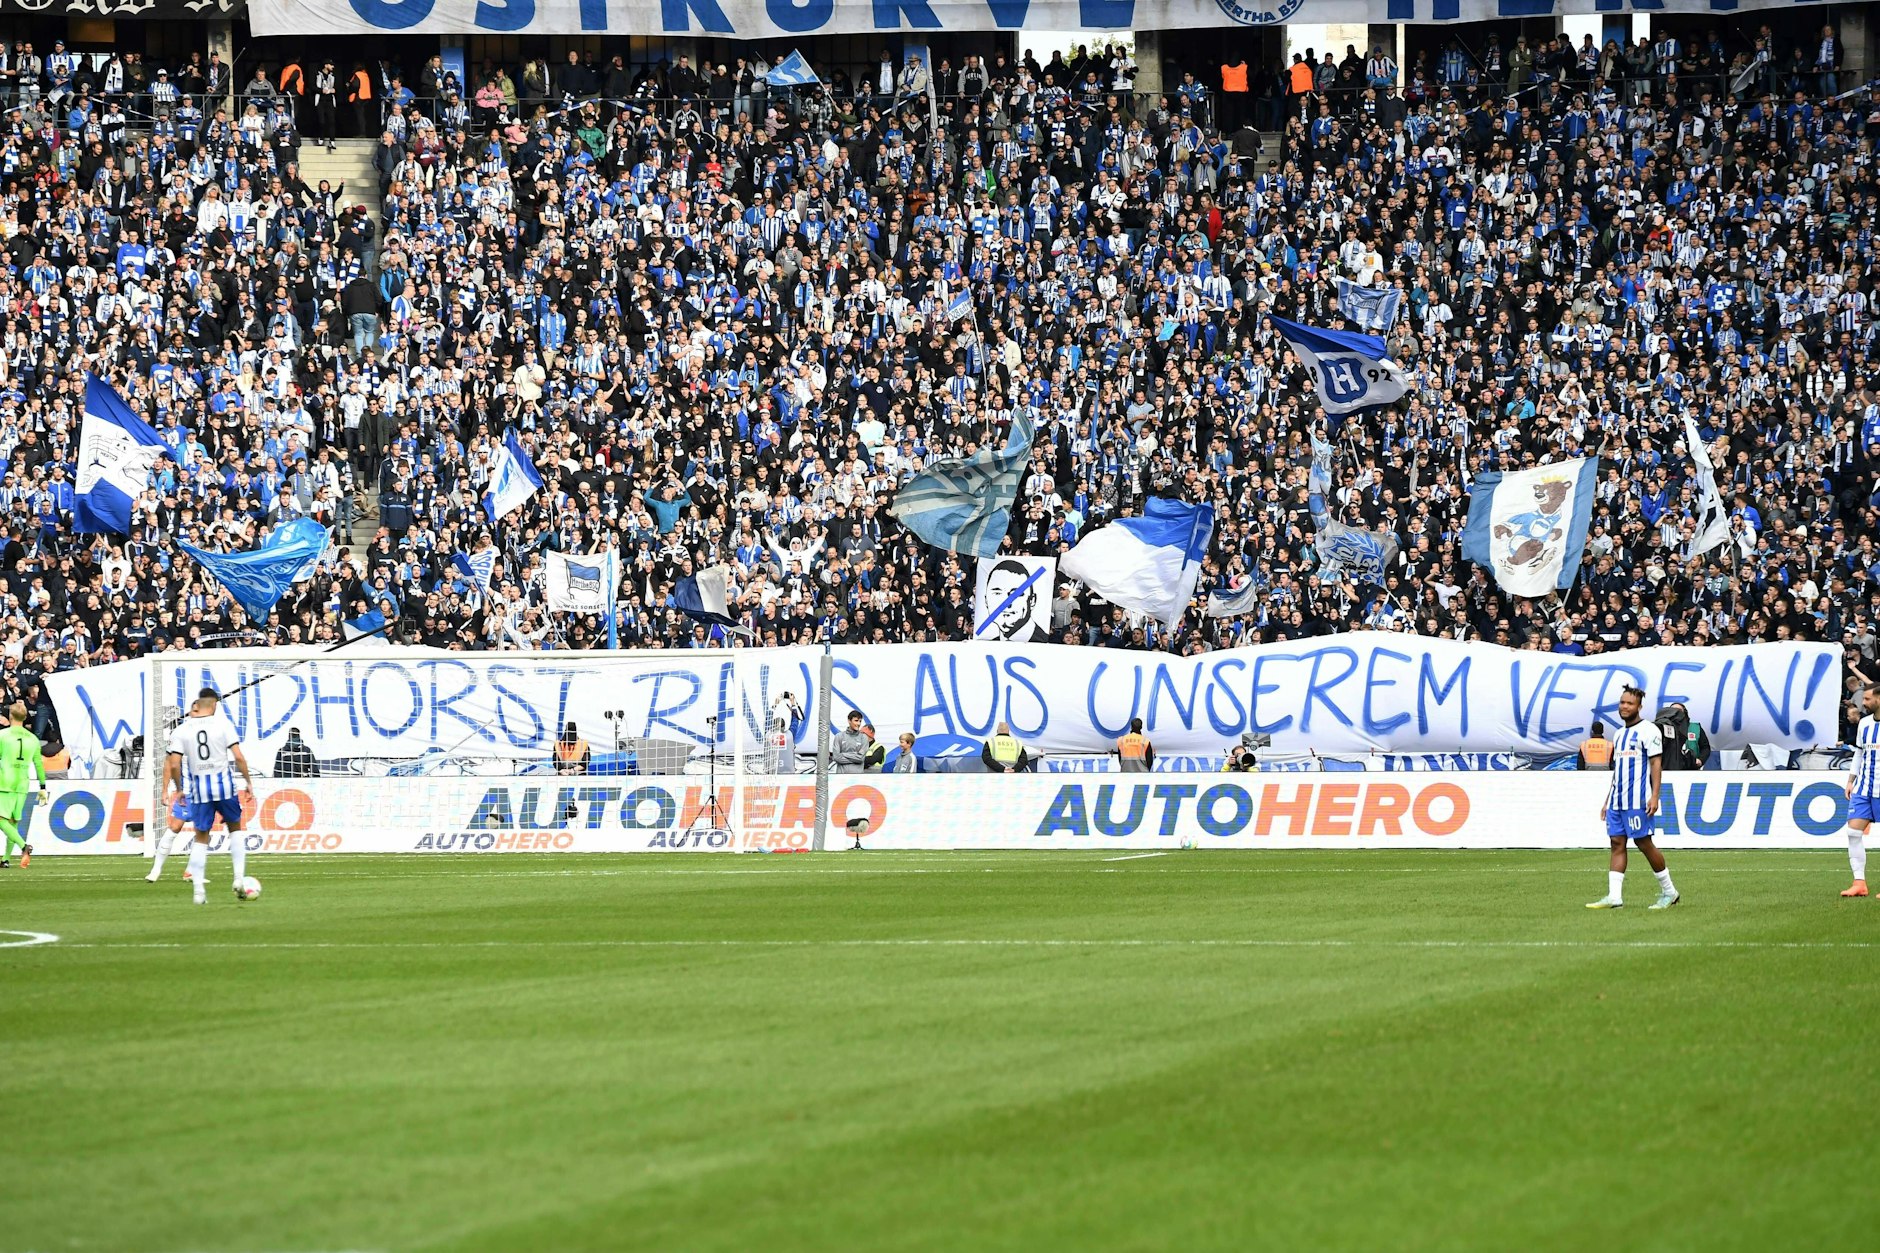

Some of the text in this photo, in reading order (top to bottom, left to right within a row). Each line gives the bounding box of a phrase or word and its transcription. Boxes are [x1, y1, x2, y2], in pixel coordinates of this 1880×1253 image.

[1367, 368, 1393, 383] 92
[76, 658, 602, 750] WINDHORST
[632, 661, 873, 746] RAUS
[913, 653, 1049, 738] AUS
[1087, 645, 1472, 739] UNSEREM
[16, 738, 24, 761] 1
[197, 729, 211, 761] 8
[466, 784, 888, 837] AUTOHERO
[1034, 782, 1471, 837] AUTOHERO
[1627, 814, 1642, 831] 40
[1652, 781, 1870, 837] AUTO
[413, 832, 575, 850] AUTOHERO
